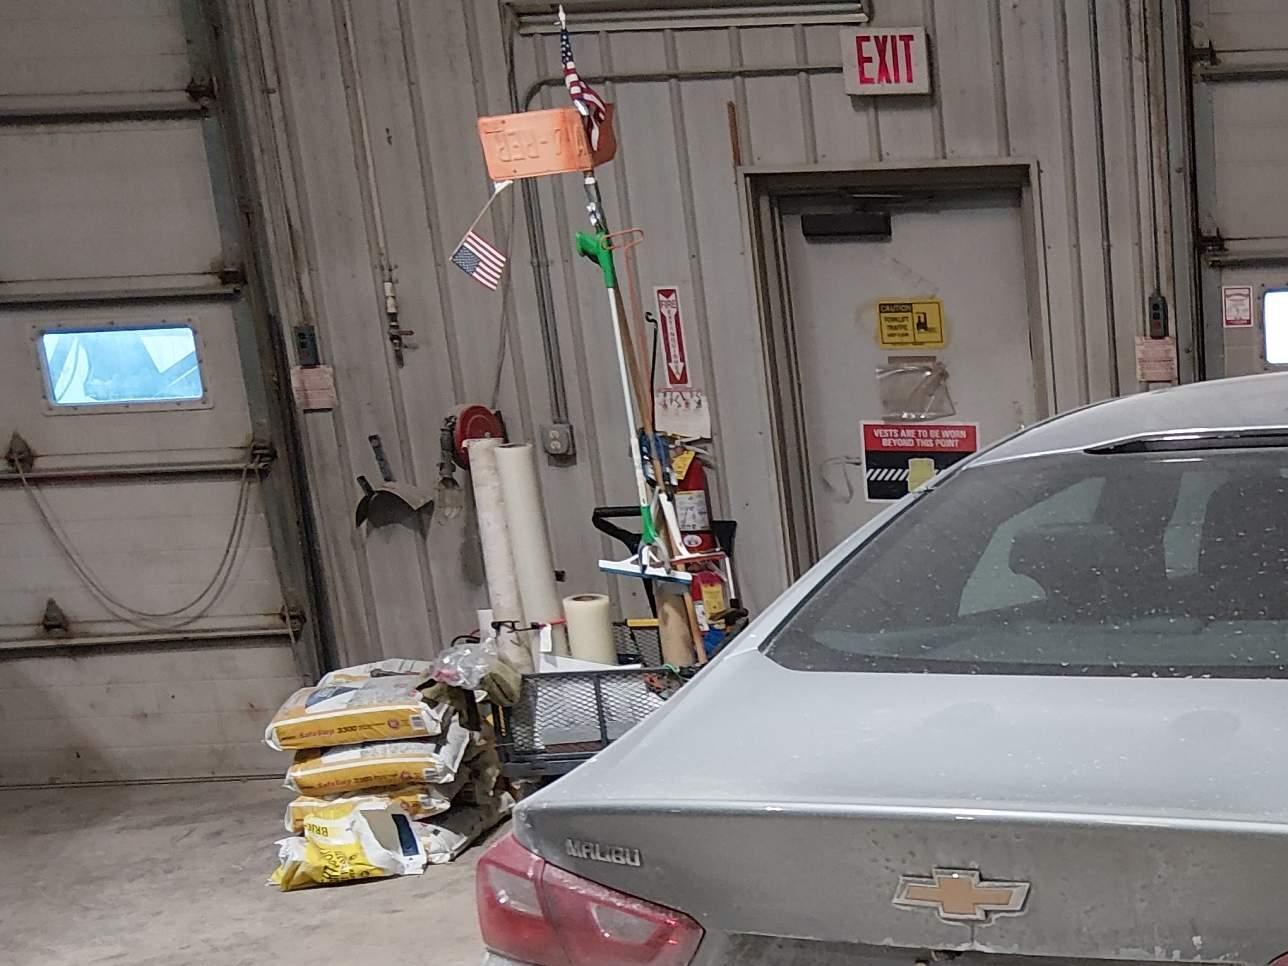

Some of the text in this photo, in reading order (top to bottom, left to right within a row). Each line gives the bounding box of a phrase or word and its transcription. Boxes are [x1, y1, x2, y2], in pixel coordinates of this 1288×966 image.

[856, 34, 914, 84] EXIT
[880, 304, 912, 312] CAUTION
[874, 429, 966, 439] VESTS ARE TO BE WORN
[882, 439, 959, 448] BEYOND THIS POINT
[566, 838, 641, 867] MALIBU
